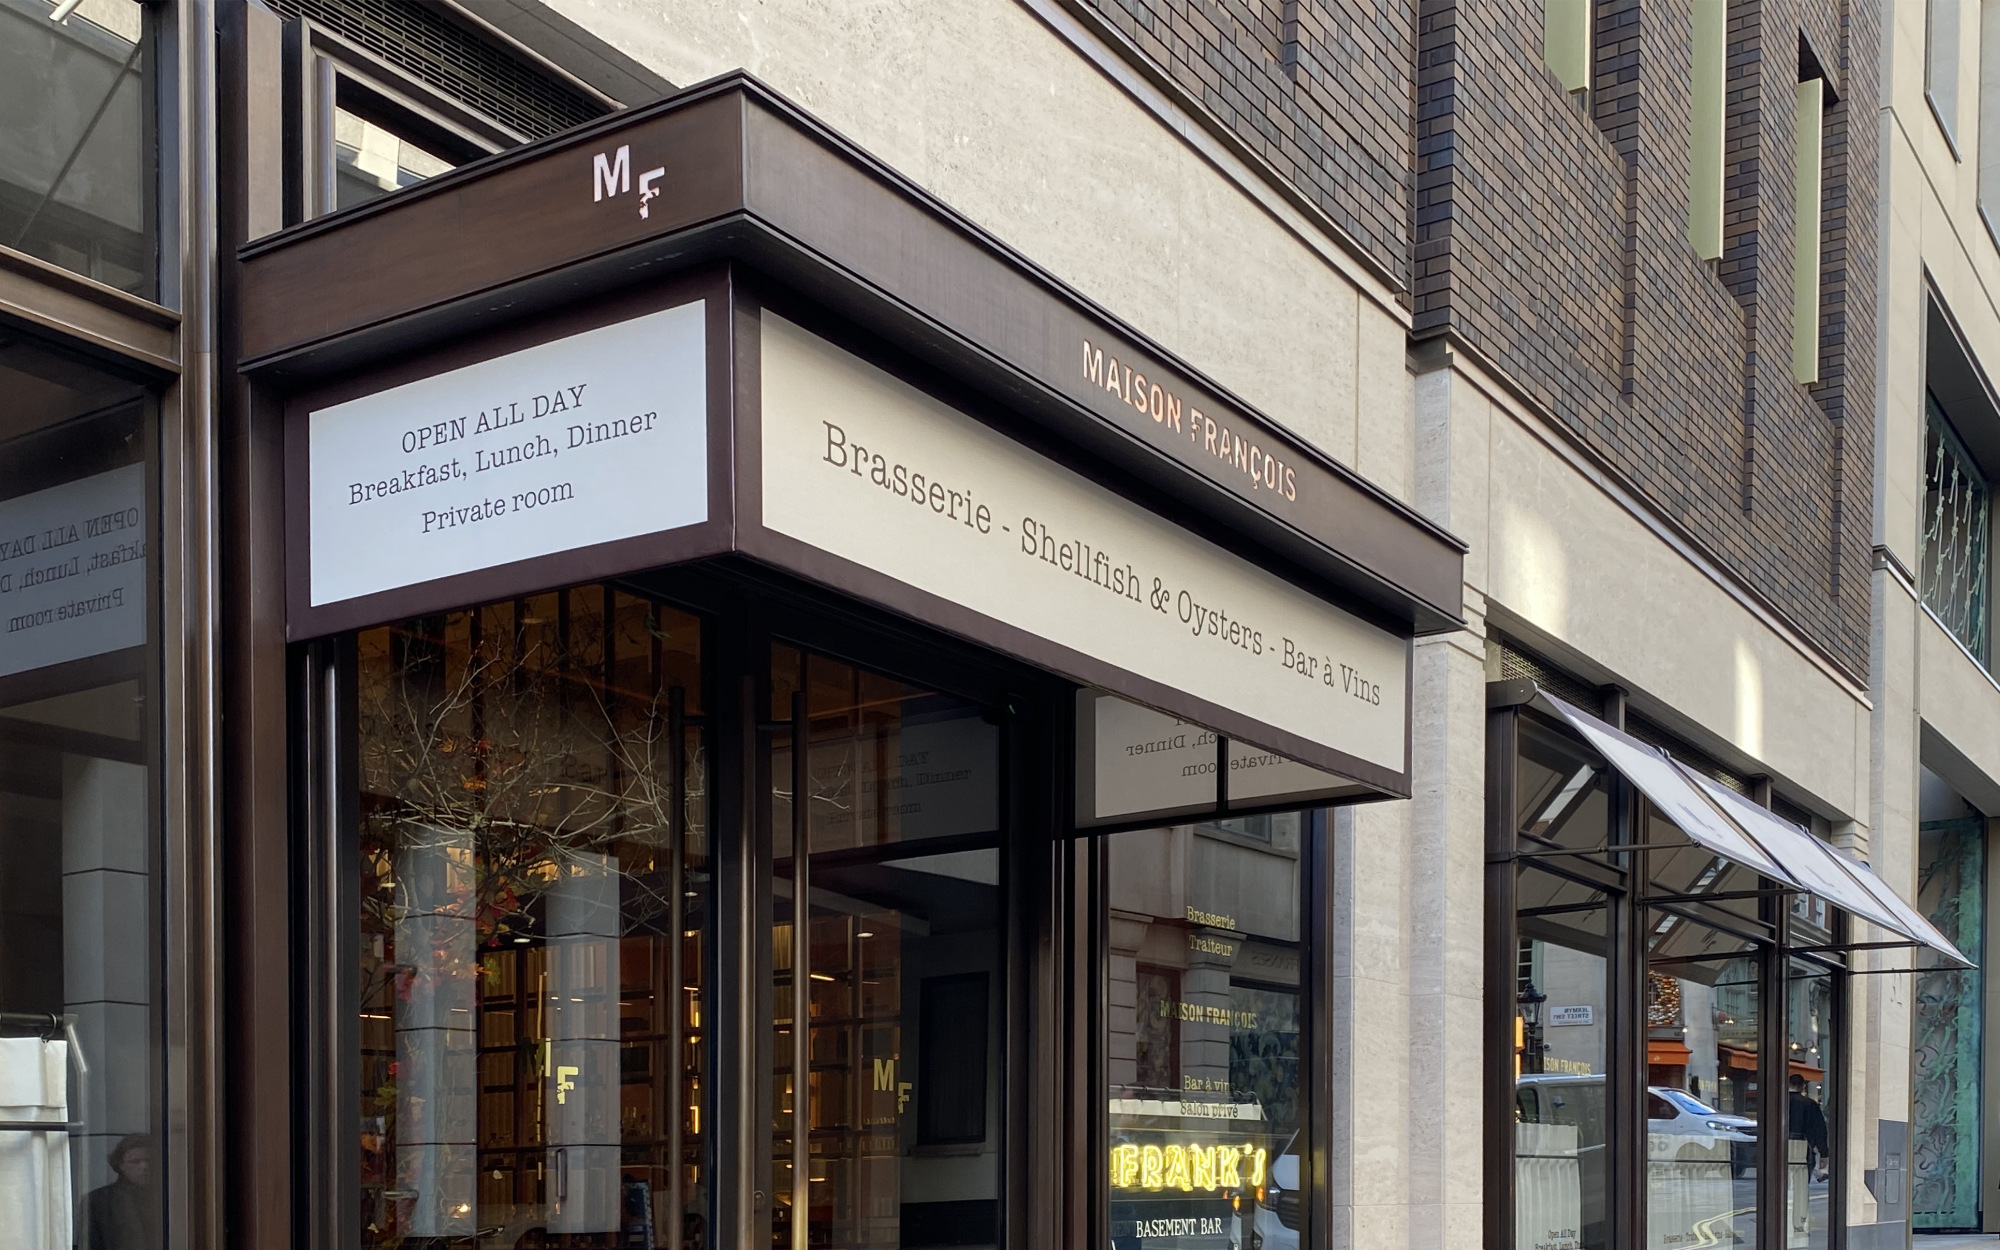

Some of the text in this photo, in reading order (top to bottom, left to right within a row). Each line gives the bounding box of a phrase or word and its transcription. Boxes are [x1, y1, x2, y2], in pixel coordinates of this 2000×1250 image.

[402, 384, 587, 453] OPEN ALL DAY
[1083, 339, 1296, 502] MAISON FRANÇOIS
[349, 411, 657, 505] Breakfast, Lunch, Dinner
[422, 482, 574, 533] Private room
[822, 419, 991, 534] Brasserie
[1021, 517, 1142, 603] Shellfish
[1150, 576, 1170, 614] &
[1178, 590, 1262, 655] Oysters
[1282, 637, 1318, 679] Bar
[1323, 656, 1334, 688] à
[1340, 663, 1381, 706] Vins
[1186, 905, 1236, 930] Brasserie
[1189, 934, 1233, 957] Traiteur
[1160, 1000, 1203, 1022] MAISON
[1183, 1075, 1203, 1091] Bar
[1180, 1100, 1239, 1120] Salon privé
[1136, 1218, 1197, 1238] BASEMENT
[1200, 1217, 1223, 1235] BAR
